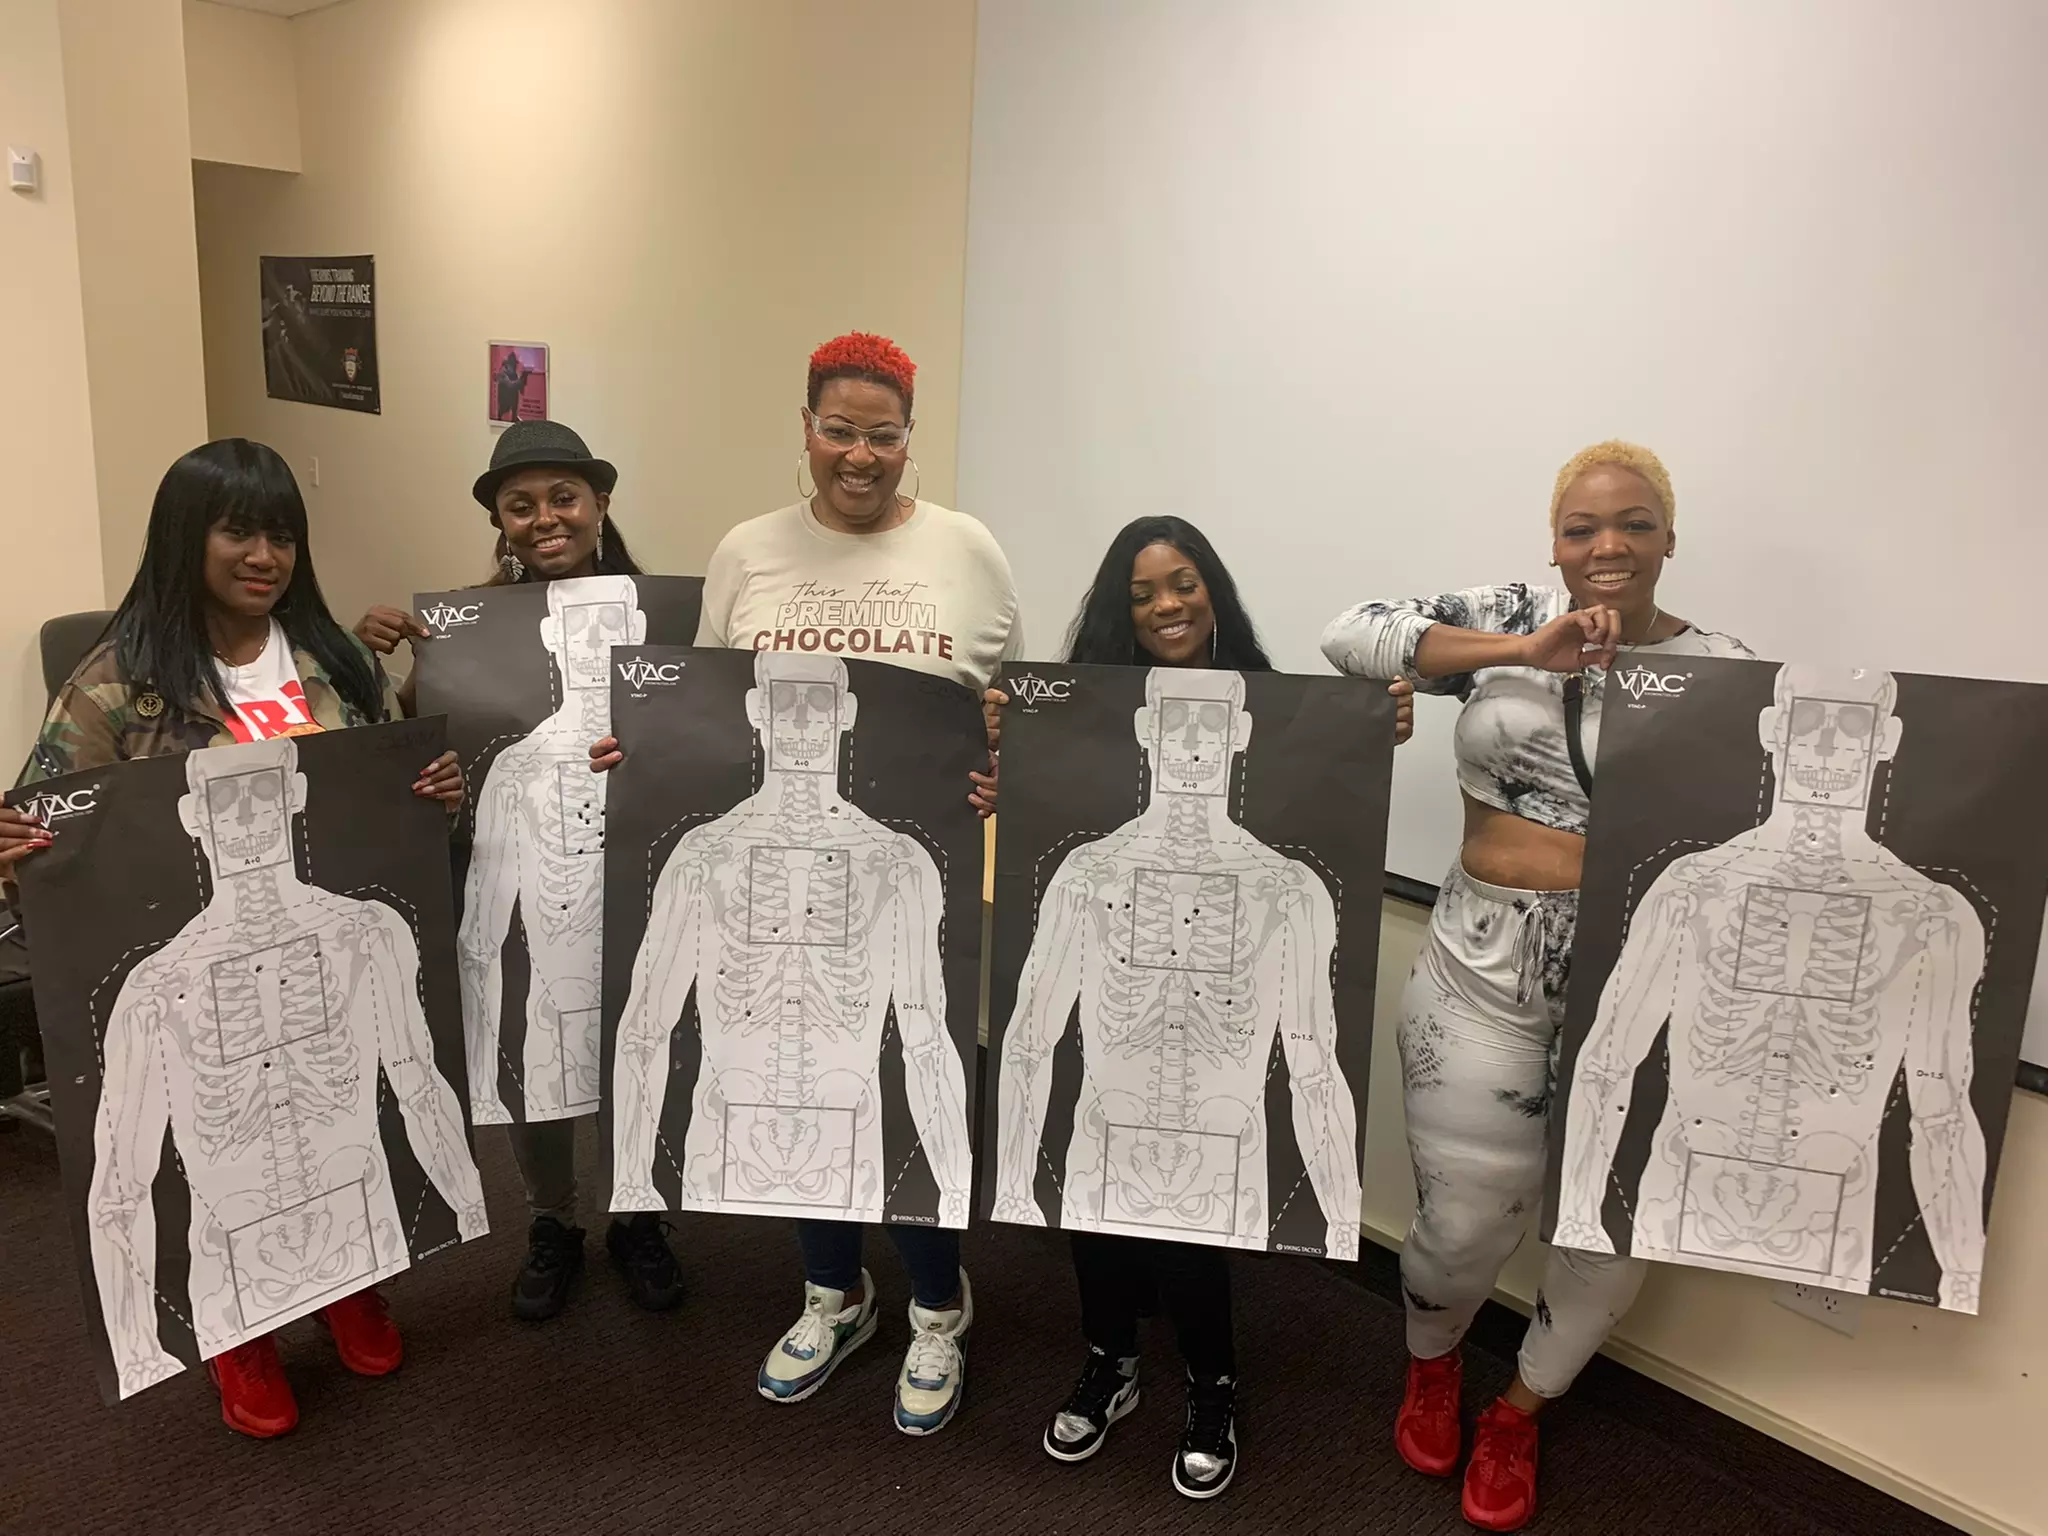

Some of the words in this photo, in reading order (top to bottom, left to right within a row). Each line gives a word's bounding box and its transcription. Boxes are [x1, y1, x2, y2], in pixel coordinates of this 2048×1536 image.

[310, 284, 336, 303] BEYOND
[346, 284, 371, 304] RANGE
[788, 579, 845, 607] this
[858, 578, 929, 607] that
[775, 600, 937, 630] PREMIUM
[753, 628, 953, 661] CHOCOLATE
[1301, 1246, 1322, 1254] TACTICS
